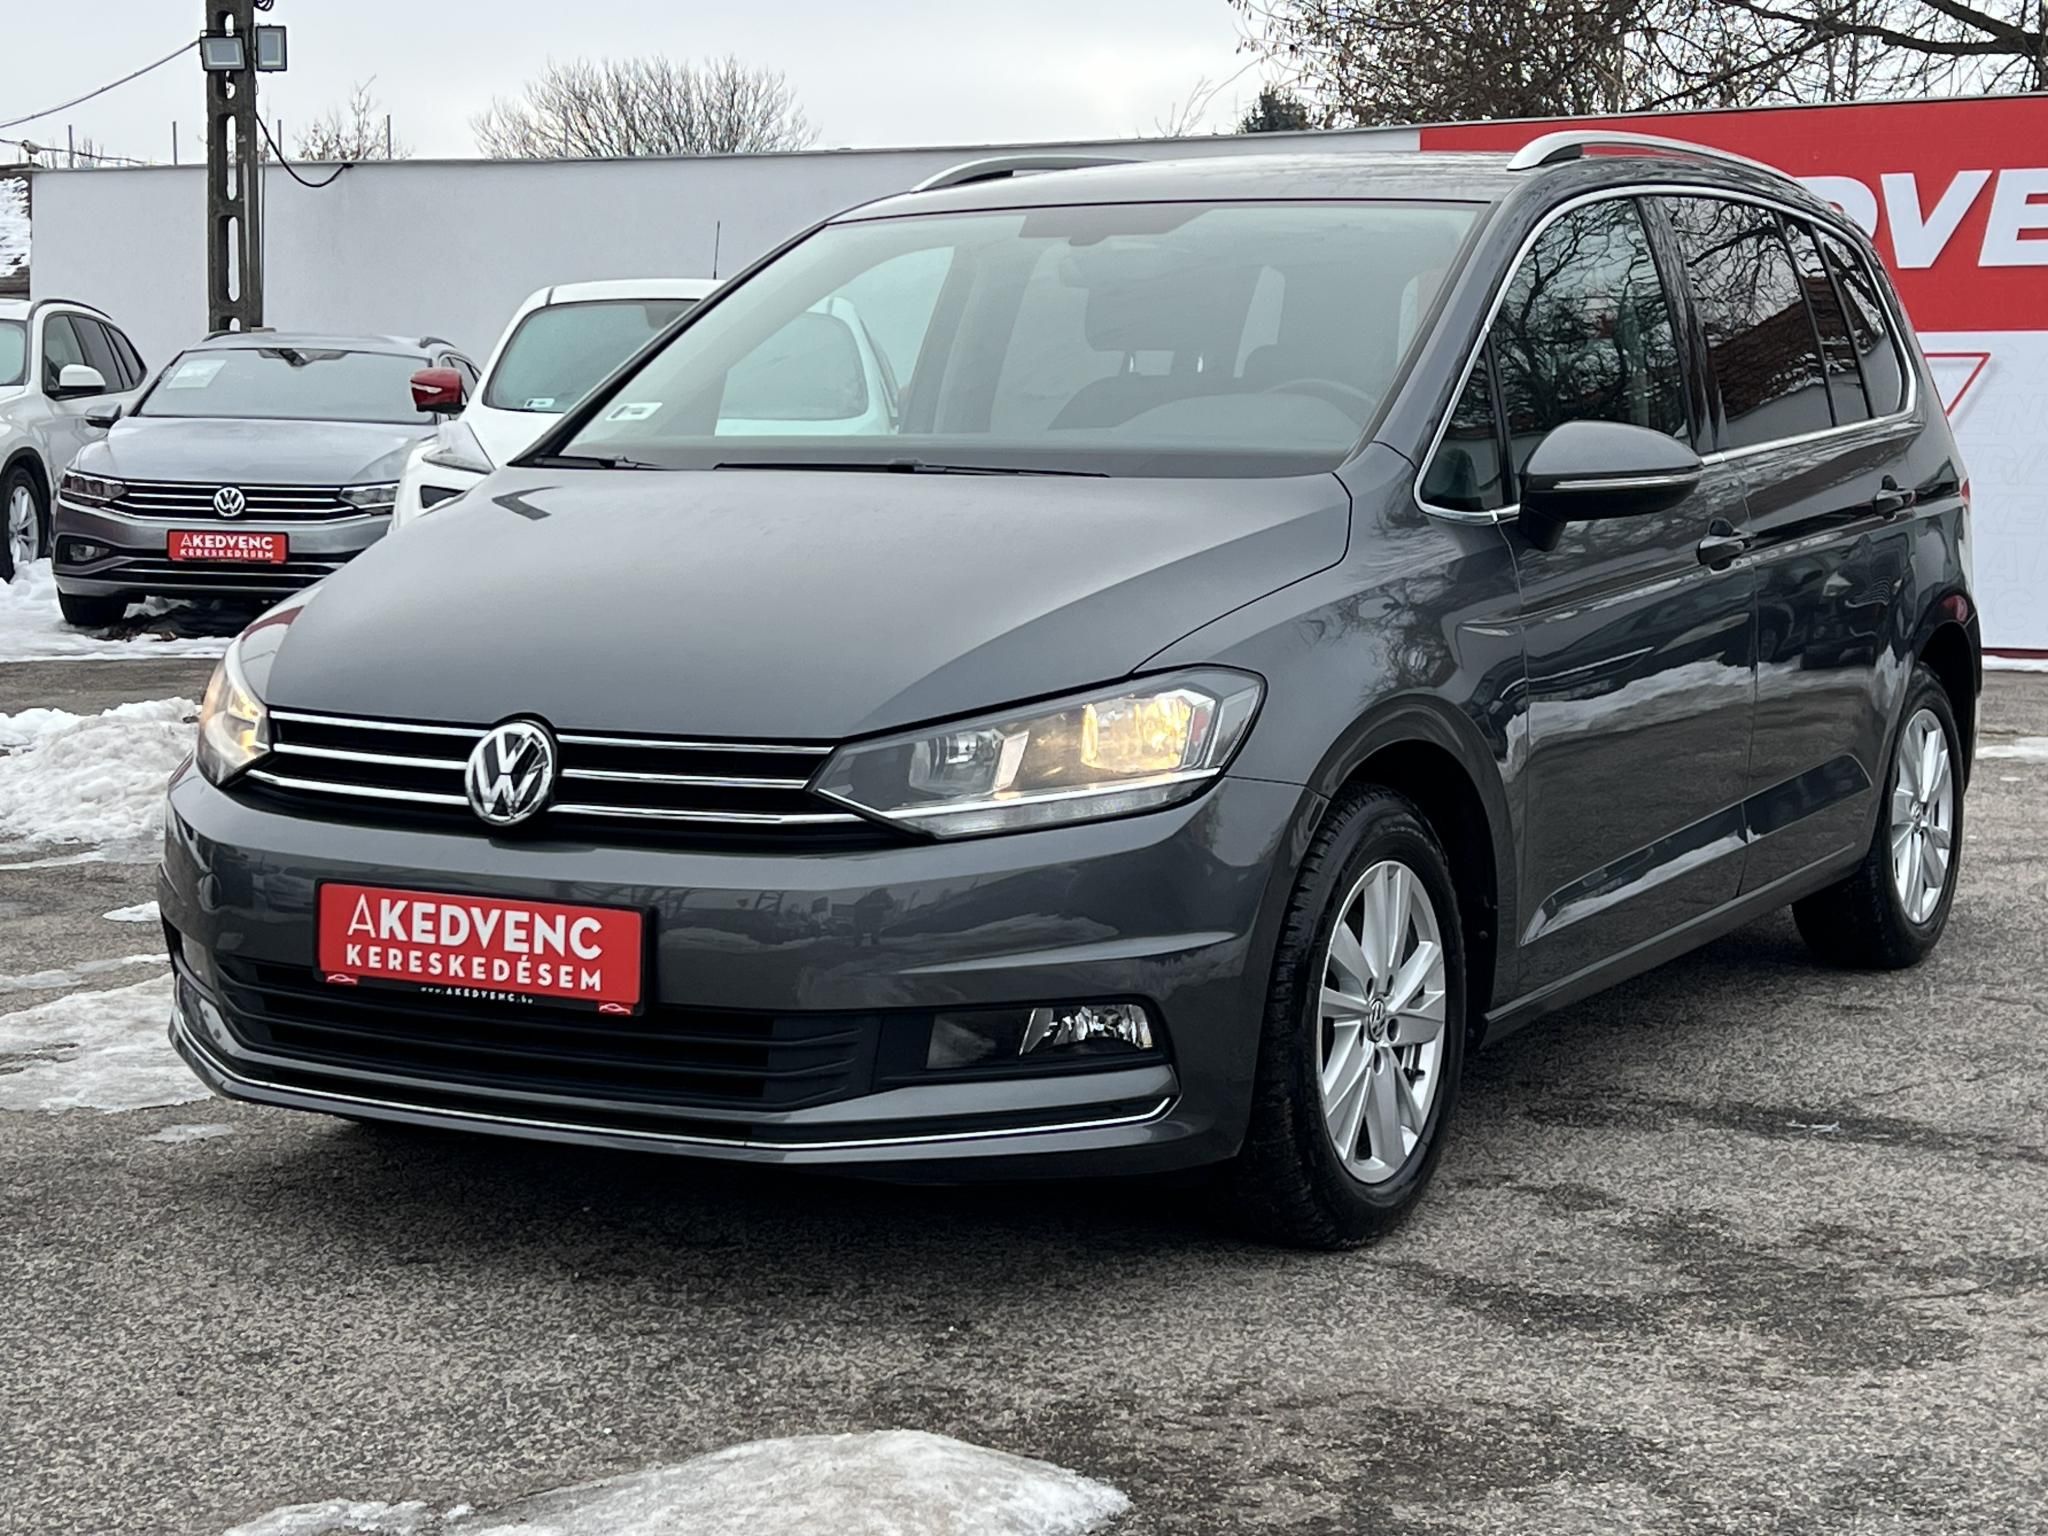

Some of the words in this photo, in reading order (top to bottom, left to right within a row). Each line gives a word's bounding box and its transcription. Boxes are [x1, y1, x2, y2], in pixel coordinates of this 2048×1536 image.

[180, 534, 273, 549] AKEDVENC
[347, 894, 602, 960] AKEDVENC
[346, 944, 601, 992] KERESKEDÉSEM
